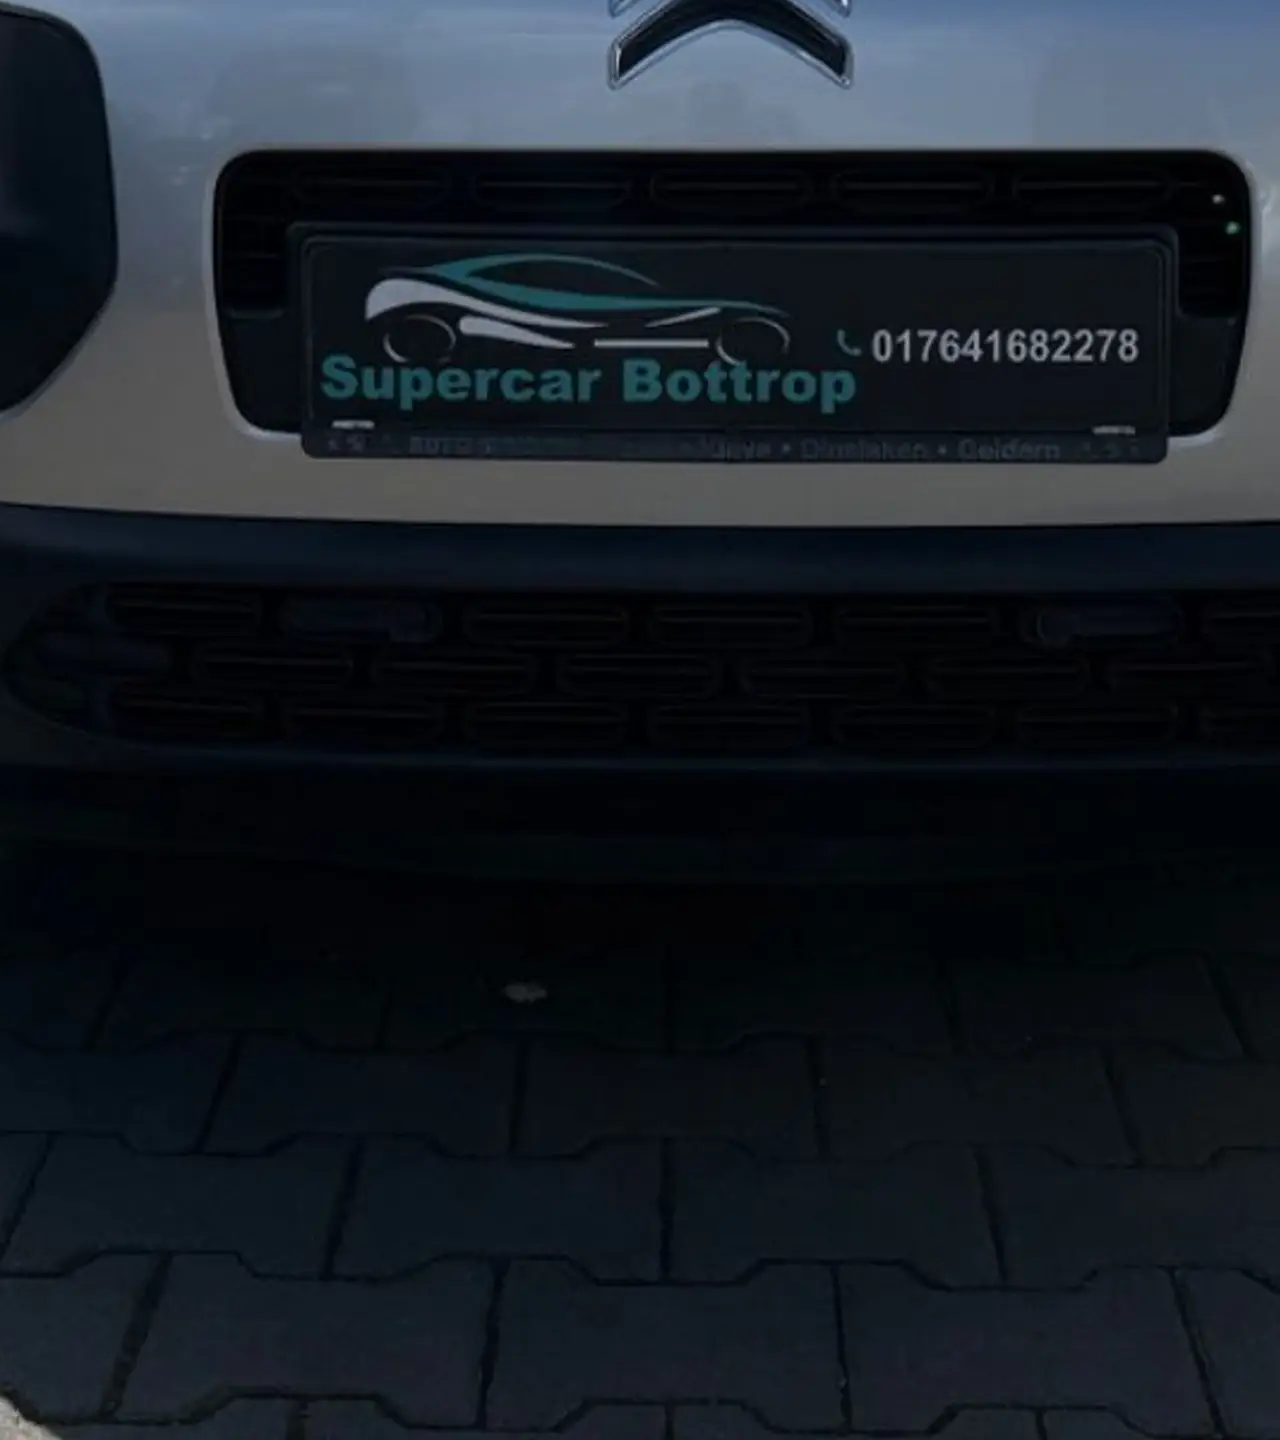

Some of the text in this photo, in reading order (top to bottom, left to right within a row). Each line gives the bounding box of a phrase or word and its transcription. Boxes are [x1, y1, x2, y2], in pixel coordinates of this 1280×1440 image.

[872, 328, 1140, 363] 017641682278
[320, 353, 857, 414] Supercar Bottrop
